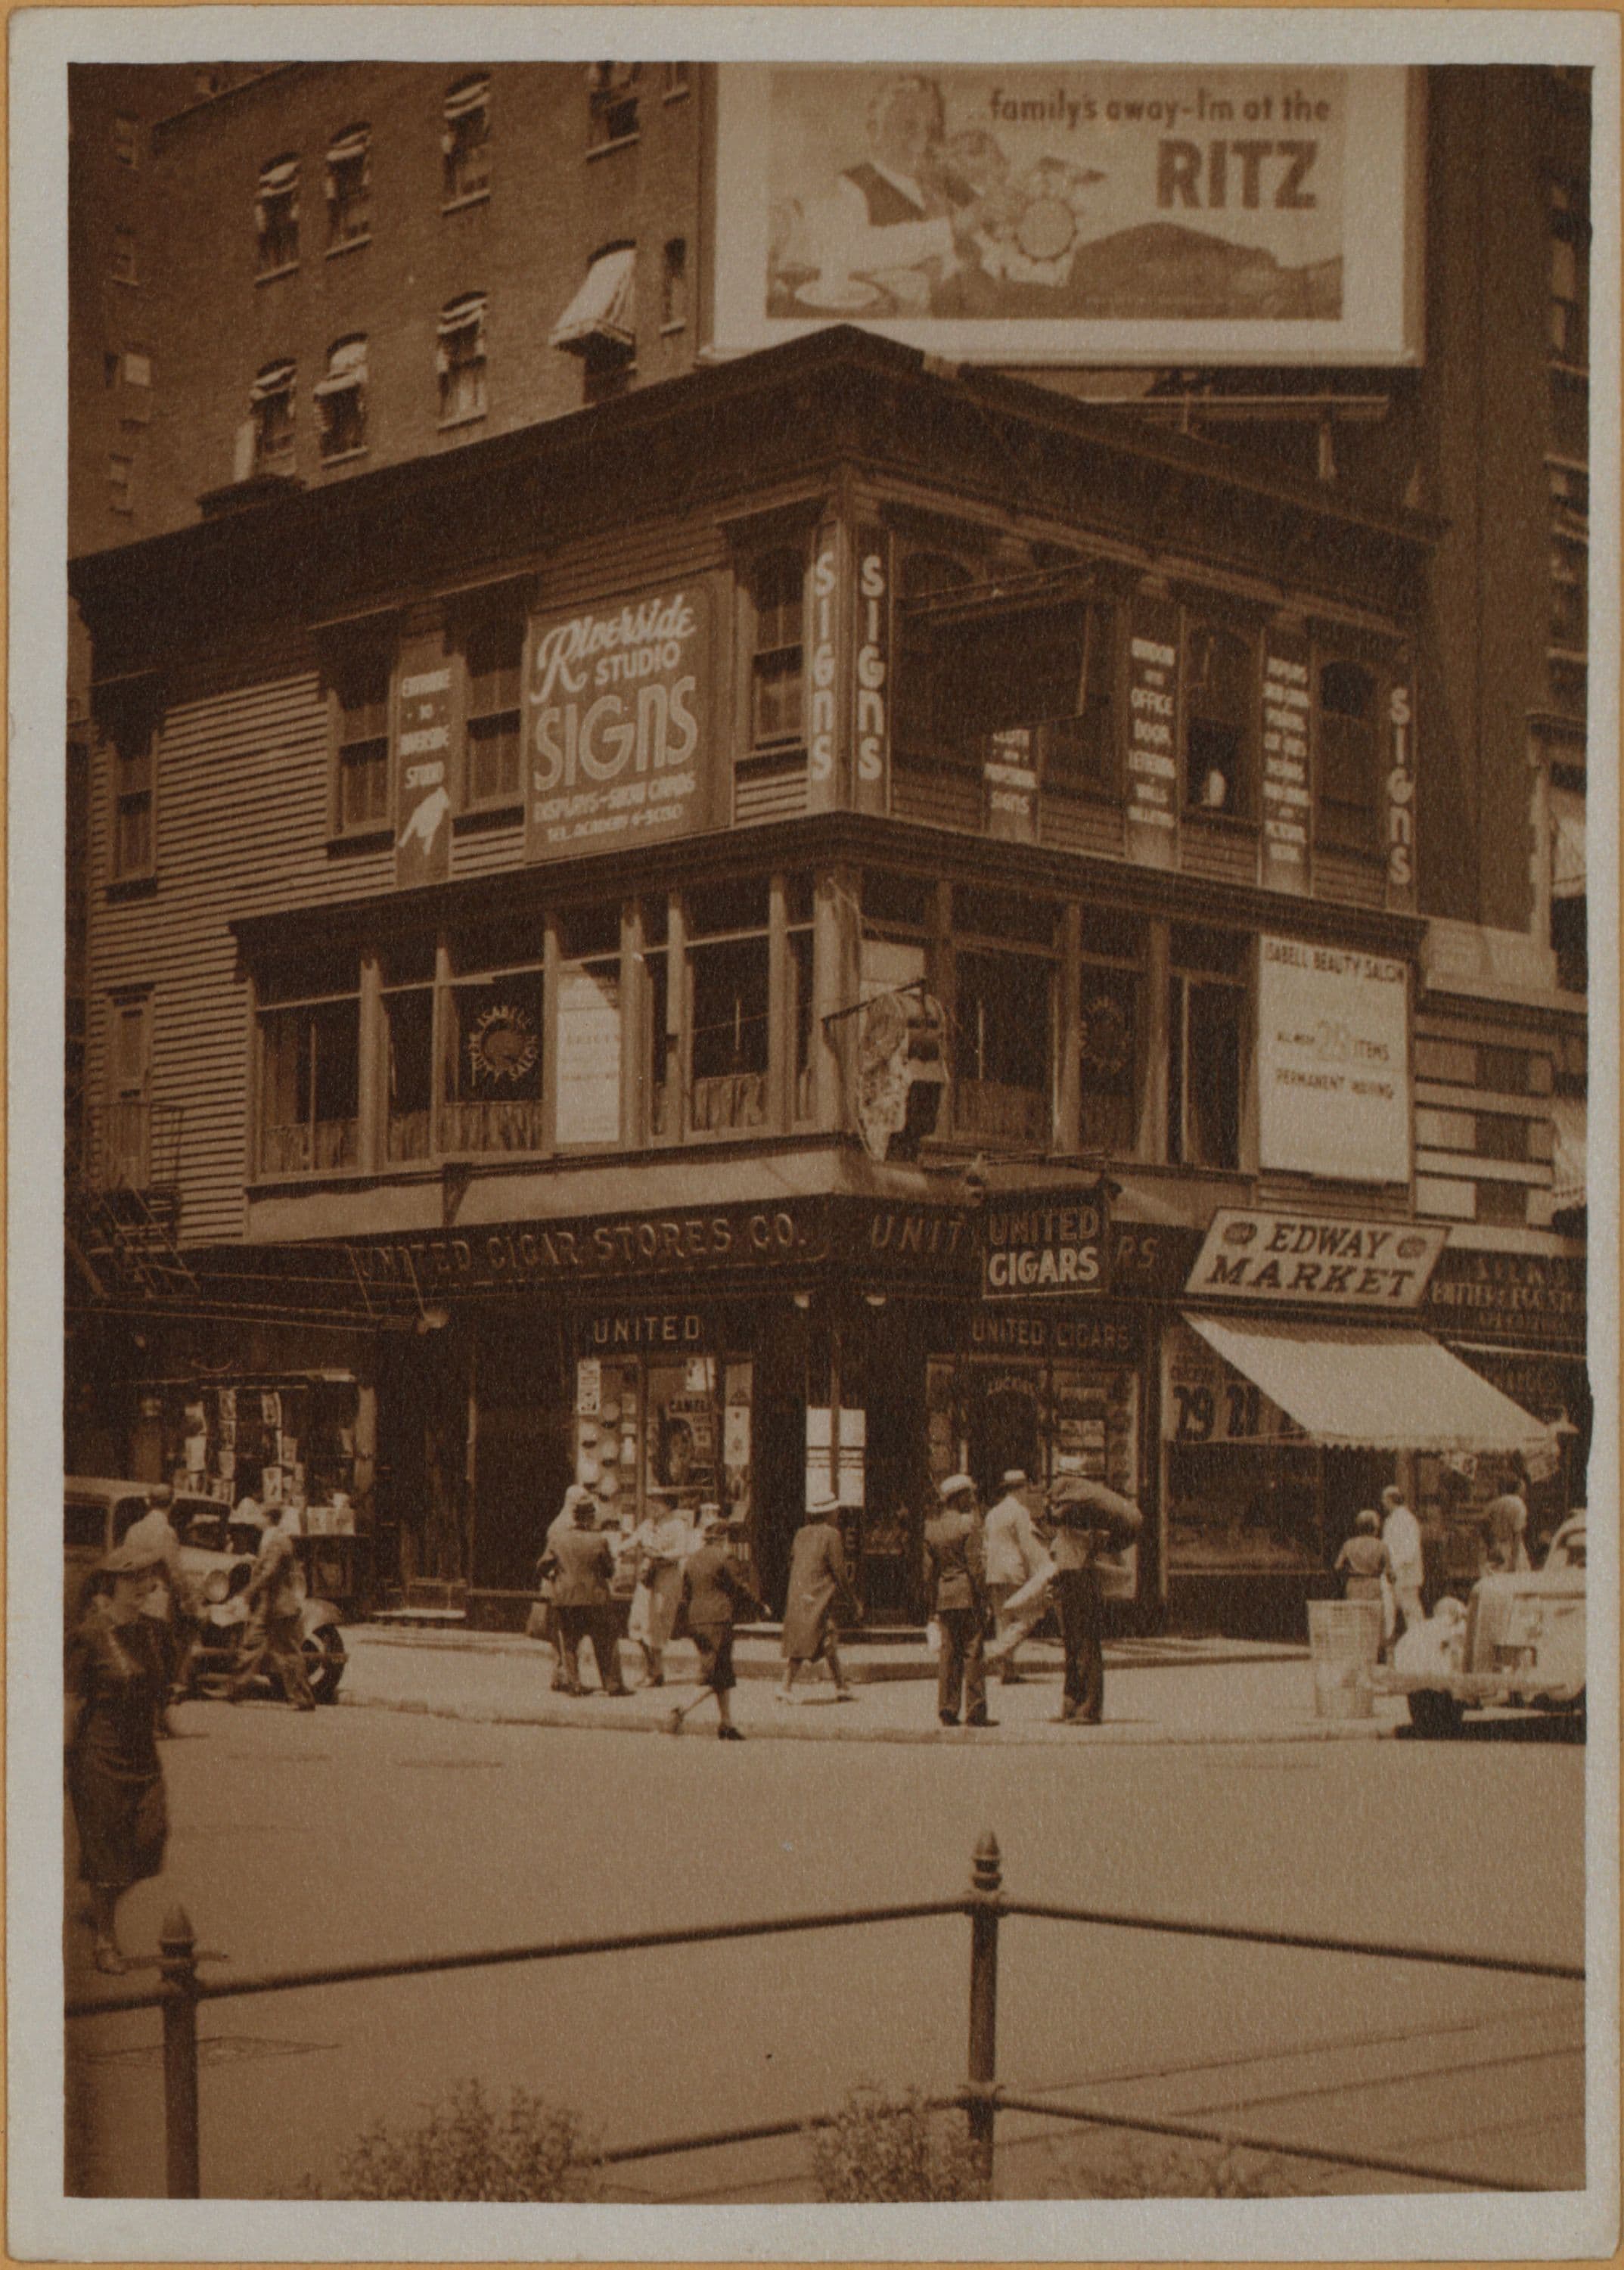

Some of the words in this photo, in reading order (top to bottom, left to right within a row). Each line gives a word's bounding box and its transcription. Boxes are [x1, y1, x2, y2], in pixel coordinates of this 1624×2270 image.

[1242, 94, 1272, 122] at
[1281, 89, 1331, 122] the
[1156, 139, 1318, 209] RITZ
[595, 641, 682, 686] STUDIO
[1130, 686, 1174, 717] OFFICE
[486, 1231, 579, 1271] CIGAR
[592, 1216, 733, 1262] STORES
[747, 1213, 807, 1250] CO.
[988, 1206, 1100, 1245] UNITED
[1264, 1222, 1393, 1259] EDWAY
[987, 1245, 1101, 1287] CIGARS
[1205, 1254, 1416, 1297] MARKET
[593, 1314, 701, 1344] UNITED
[971, 1318, 1043, 1346] UNITED
[1057, 1321, 1130, 1349] CIGARS
